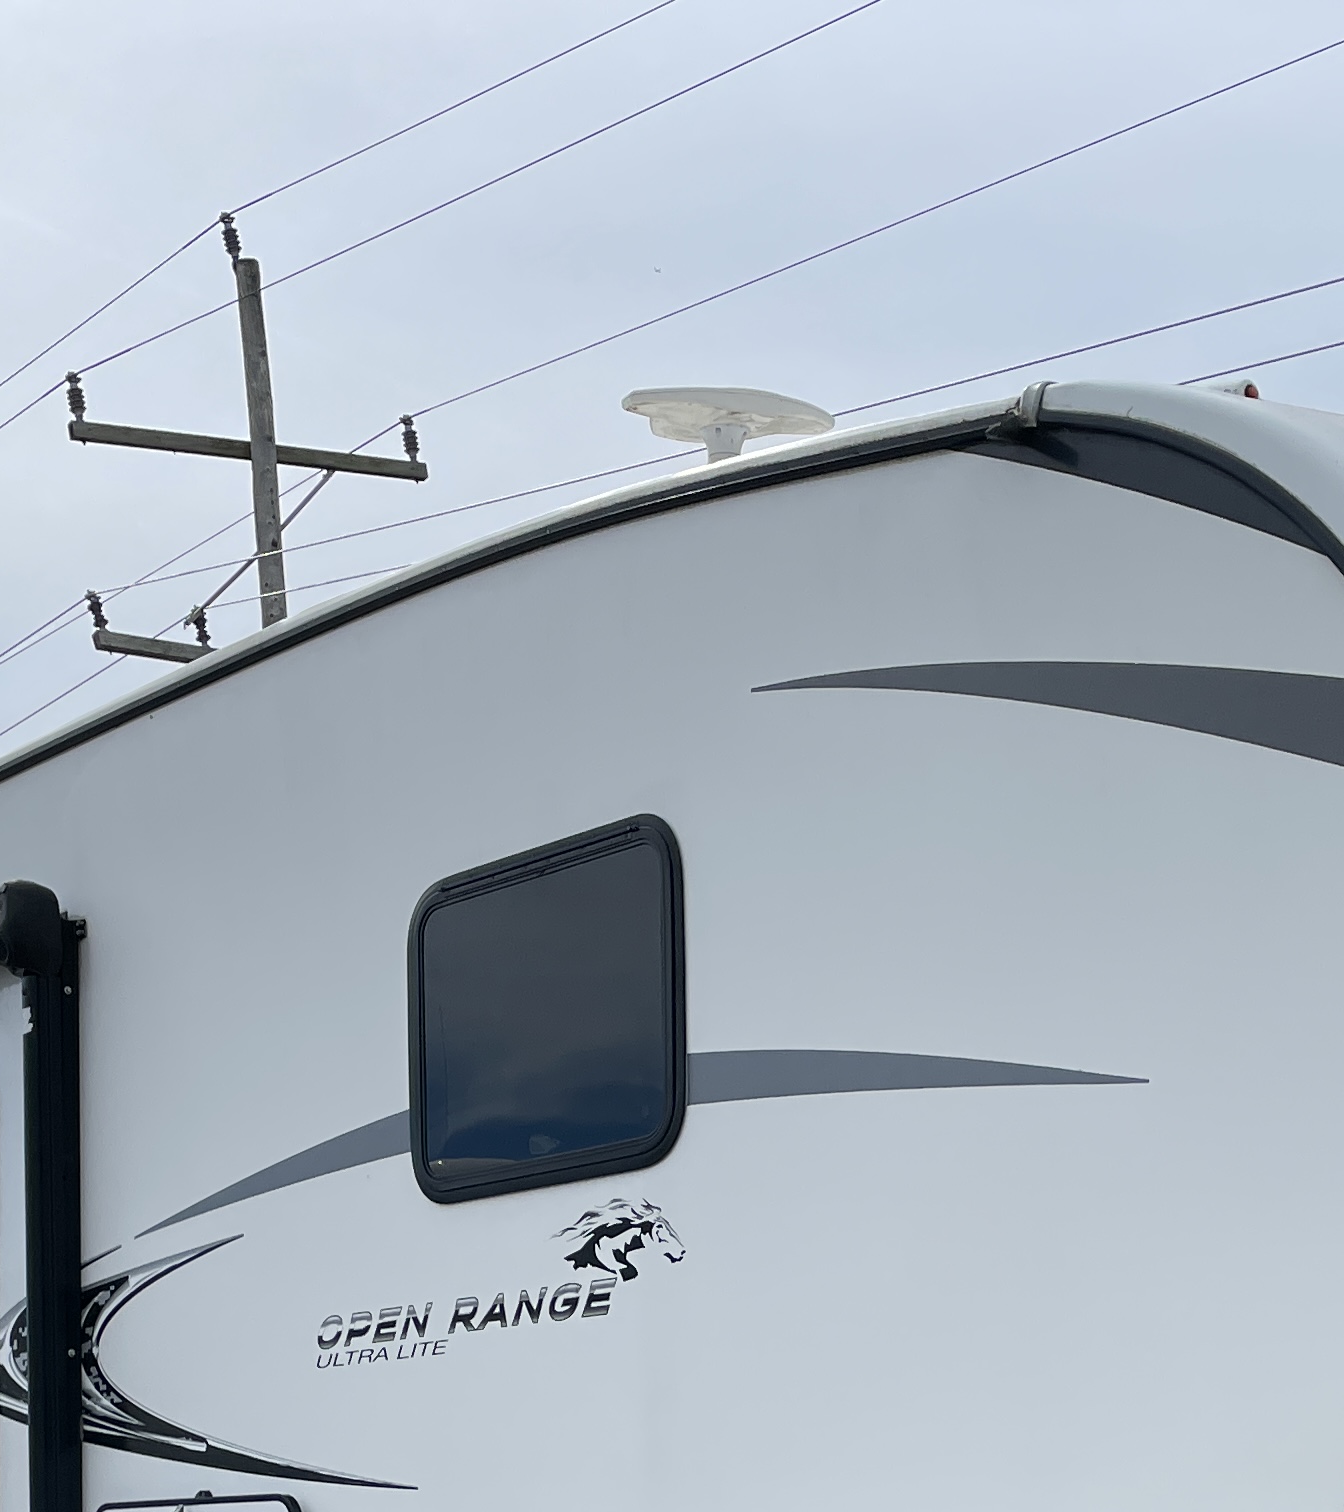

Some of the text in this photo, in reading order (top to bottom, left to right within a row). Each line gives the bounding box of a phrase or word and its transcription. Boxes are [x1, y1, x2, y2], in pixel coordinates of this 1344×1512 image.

[316, 1276, 618, 1350] OPEN RANGE
[315, 1339, 449, 1369] ULTRA LITE
